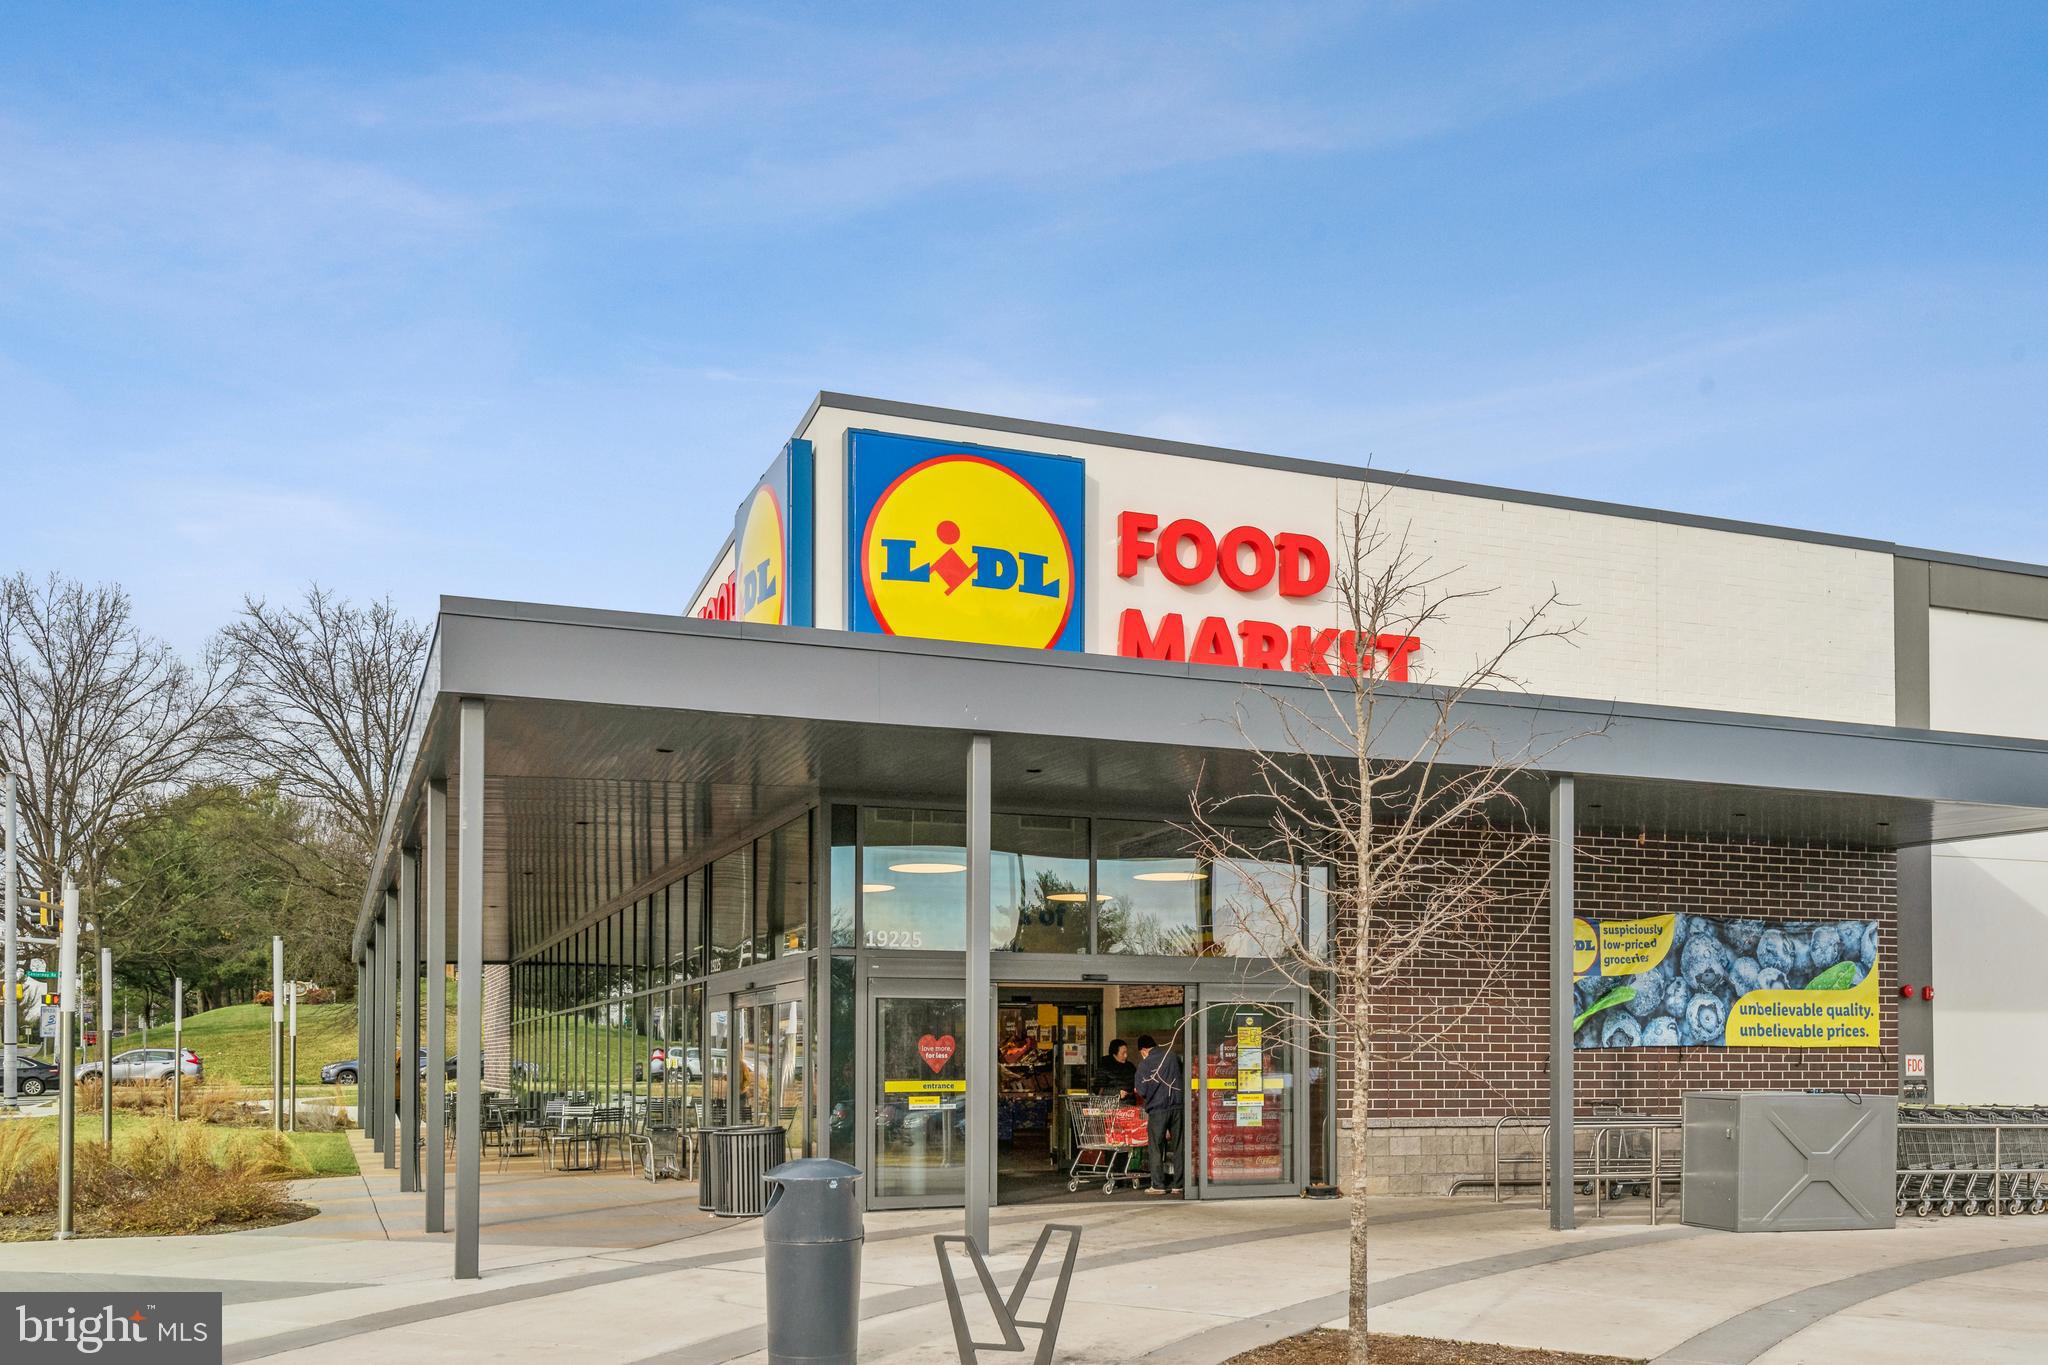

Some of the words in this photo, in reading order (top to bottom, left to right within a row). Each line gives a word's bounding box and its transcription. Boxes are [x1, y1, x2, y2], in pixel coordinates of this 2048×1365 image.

[1117, 511, 1331, 597] FOOD
[743, 558, 776, 616] DL
[1117, 608, 1420, 682] MARKET
[866, 930, 922, 947] 19225
[1603, 924, 1663, 937] suspiciously
[1573, 939, 1596, 951] DL
[1603, 938, 1657, 951] low-priced
[1604, 953, 1649, 967] groceries
[1739, 1002, 1823, 1017] unbelievable
[1826, 1003, 1874, 1019] quality.
[1740, 1023, 1824, 1038] unbelievable
[1827, 1024, 1869, 1040] prices.
[1907, 1058, 1923, 1072] FDC
